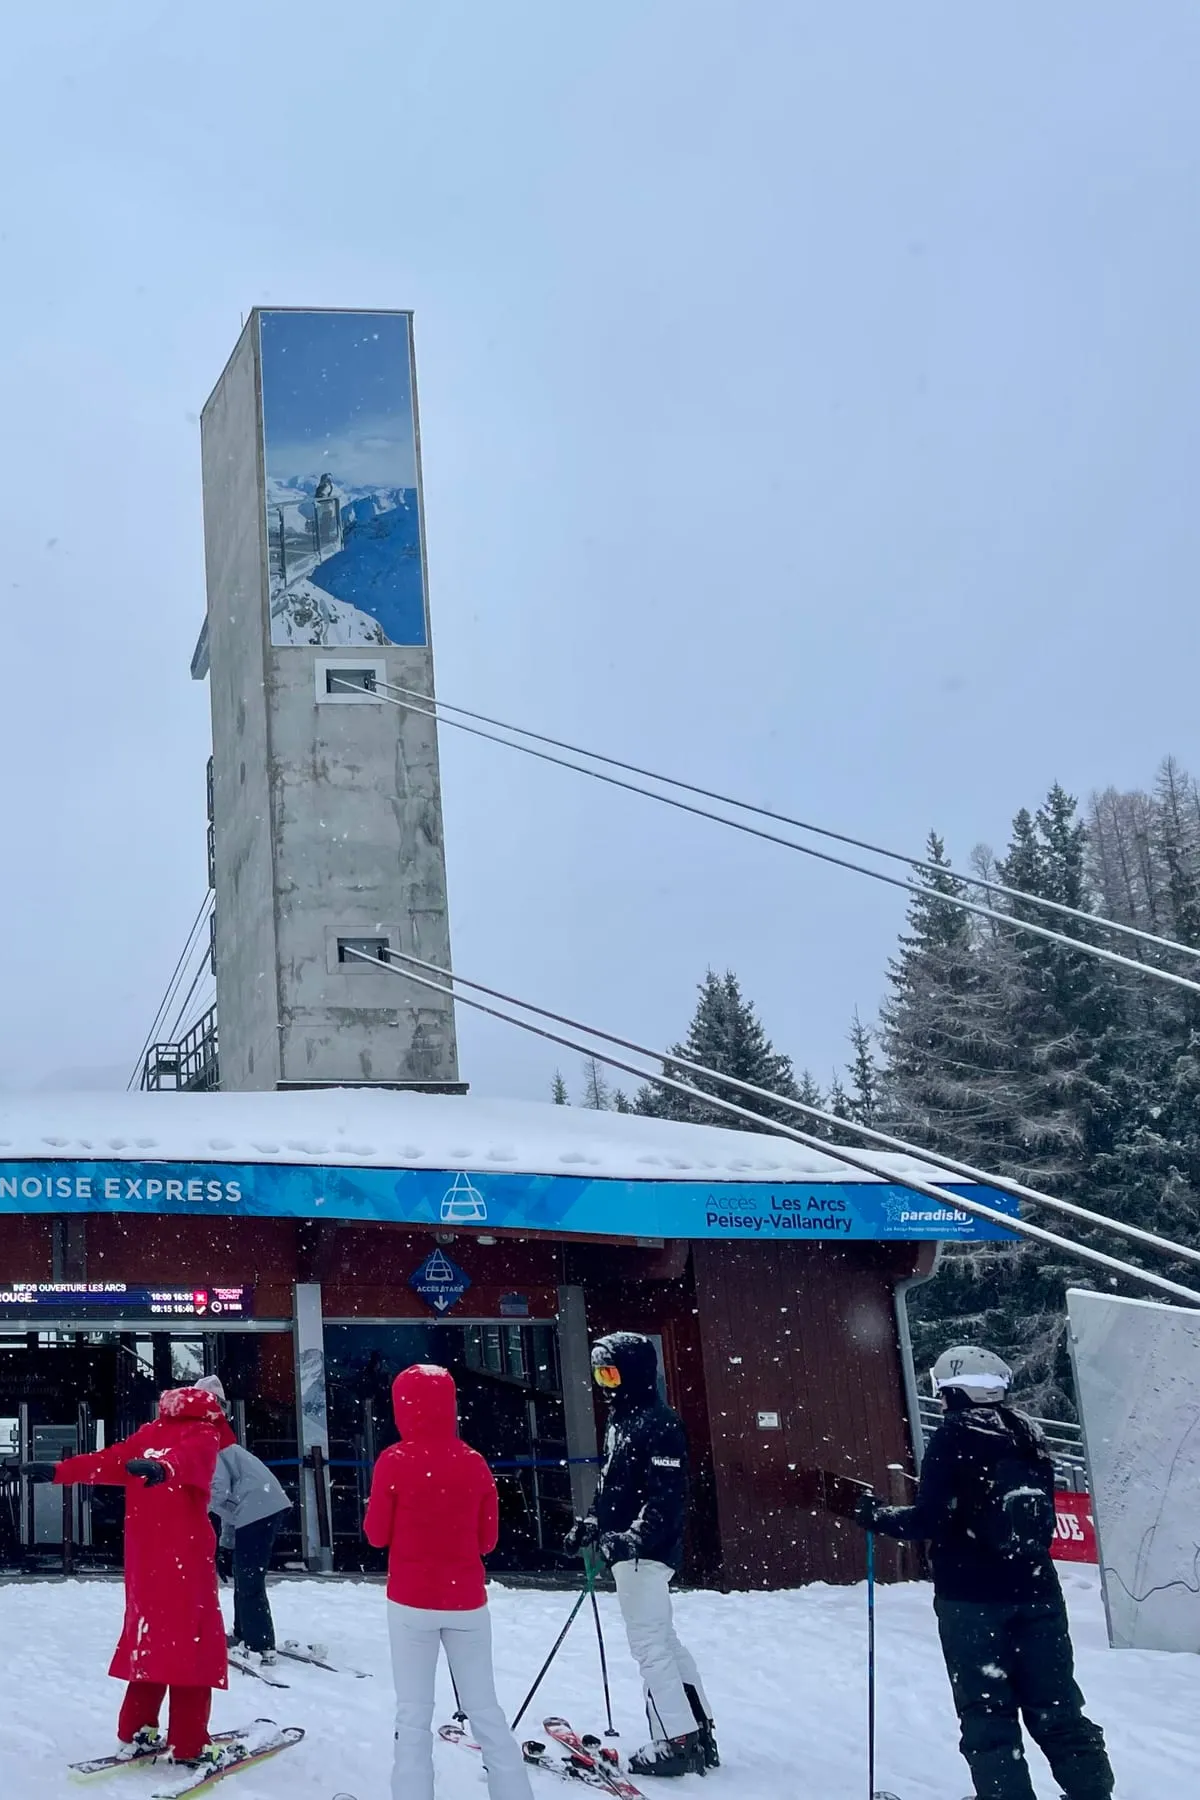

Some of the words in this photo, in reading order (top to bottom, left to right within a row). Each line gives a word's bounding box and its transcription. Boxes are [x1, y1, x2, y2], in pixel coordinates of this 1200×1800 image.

[104, 1177, 242, 1202] EXPRESS
[771, 1194, 801, 1211] Les
[807, 1195, 846, 1212] Arcs
[706, 1212, 852, 1233] Peisey-Vallandry
[13, 1284, 37, 1292] INFOS
[39, 1284, 87, 1292] OUVERTURE
[89, 1284, 103, 1292] LES
[105, 1284, 127, 1292] ARCS
